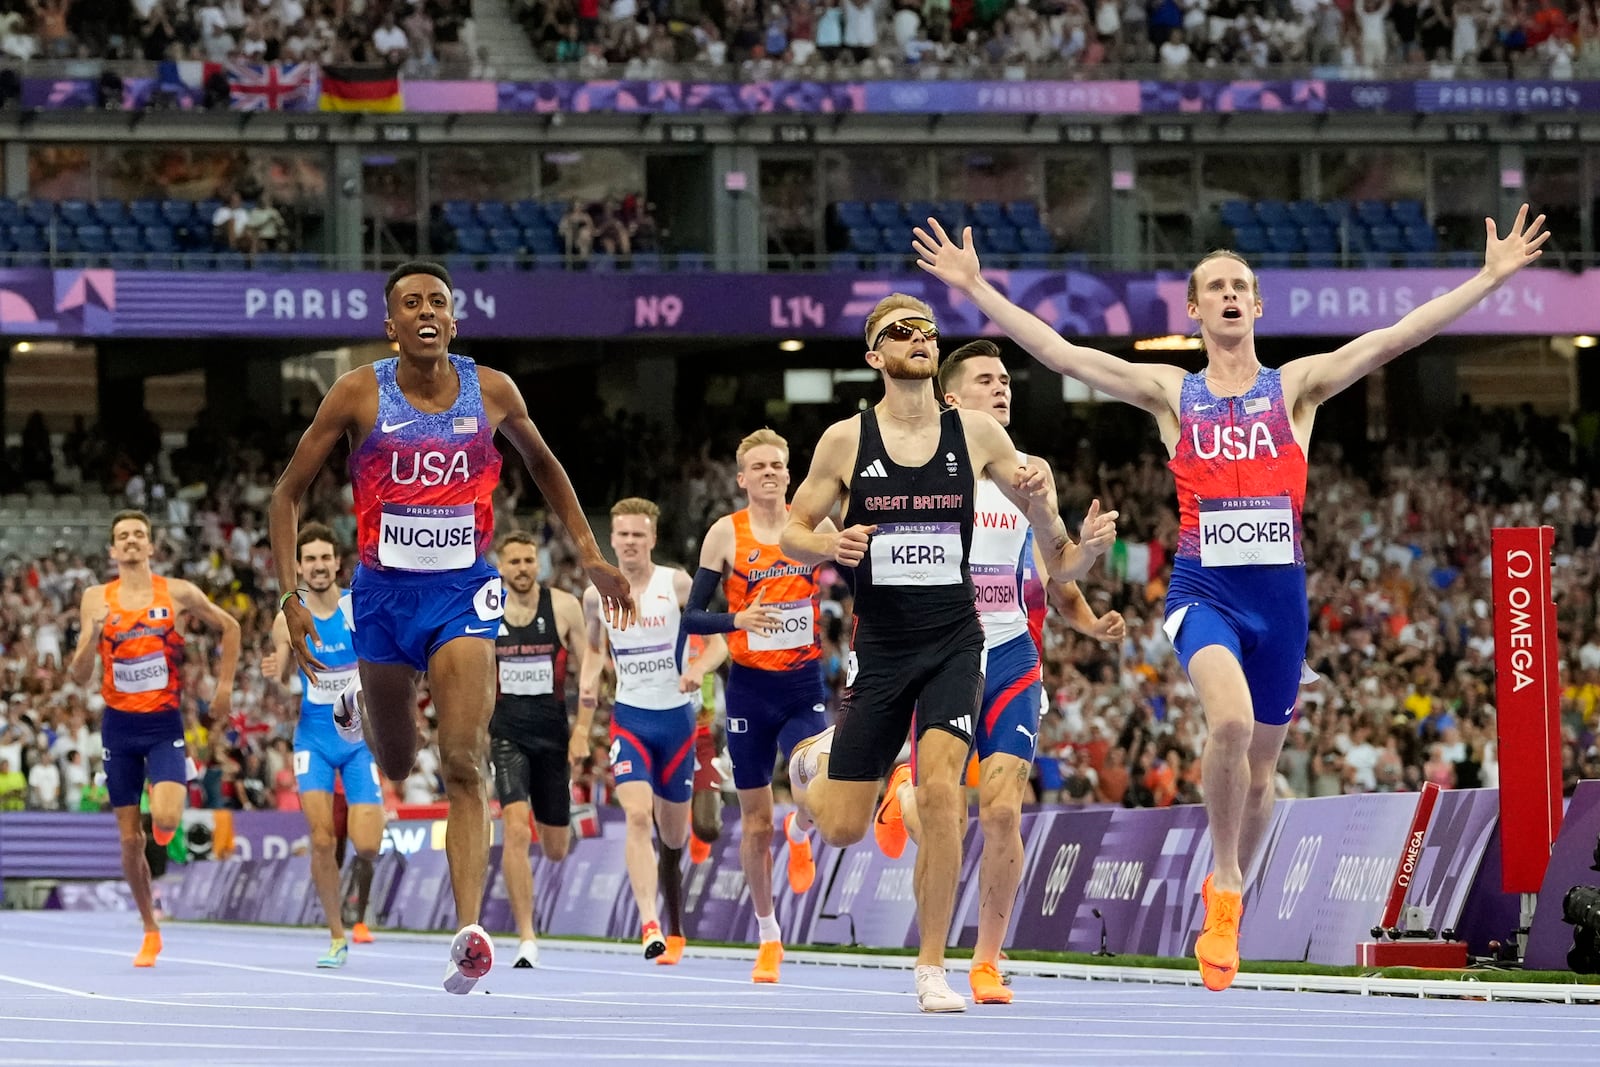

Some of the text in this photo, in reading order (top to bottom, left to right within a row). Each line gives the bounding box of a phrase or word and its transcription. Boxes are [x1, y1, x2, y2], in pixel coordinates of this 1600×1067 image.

[245, 288, 368, 320] PARIS
[634, 295, 683, 328] N9
[770, 295, 825, 328] L14
[1289, 287, 1414, 318] PARIS
[1192, 421, 1278, 460] USA
[391, 450, 470, 487] USA
[406, 508, 455, 516] PARIS 2024
[864, 494, 964, 511] GREAT BRITAIN
[1222, 499, 1272, 508] PARIS 2024
[384, 524, 473, 549] NUGUSE
[894, 524, 918, 533] PARIS
[1204, 521, 1291, 545] HOCKER
[891, 545, 946, 565] KERR
[485, 589, 499, 611] 6
[1508, 587, 1535, 692] OMEGA
[620, 656, 674, 675] NORDAS
[1403, 830, 1425, 874] OMEGA
